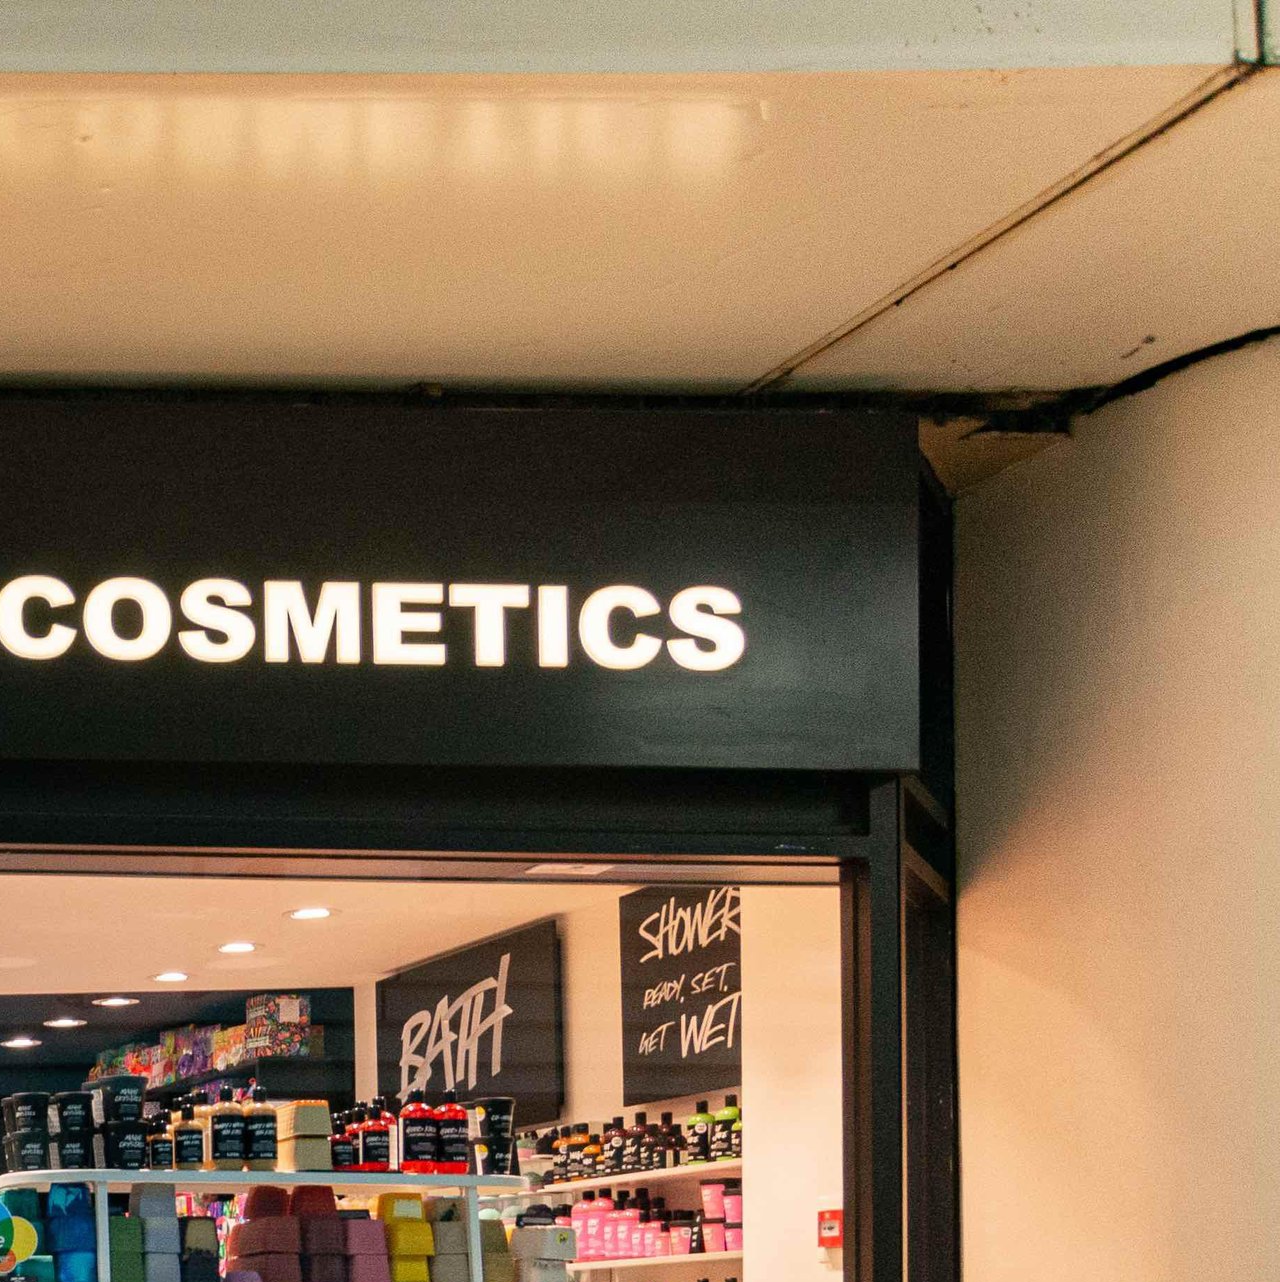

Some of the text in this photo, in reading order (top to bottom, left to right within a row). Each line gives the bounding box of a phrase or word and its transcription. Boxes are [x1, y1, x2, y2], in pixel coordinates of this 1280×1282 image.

[395, 952, 514, 1106] BATH
[639, 991, 742, 1058] GET WET
